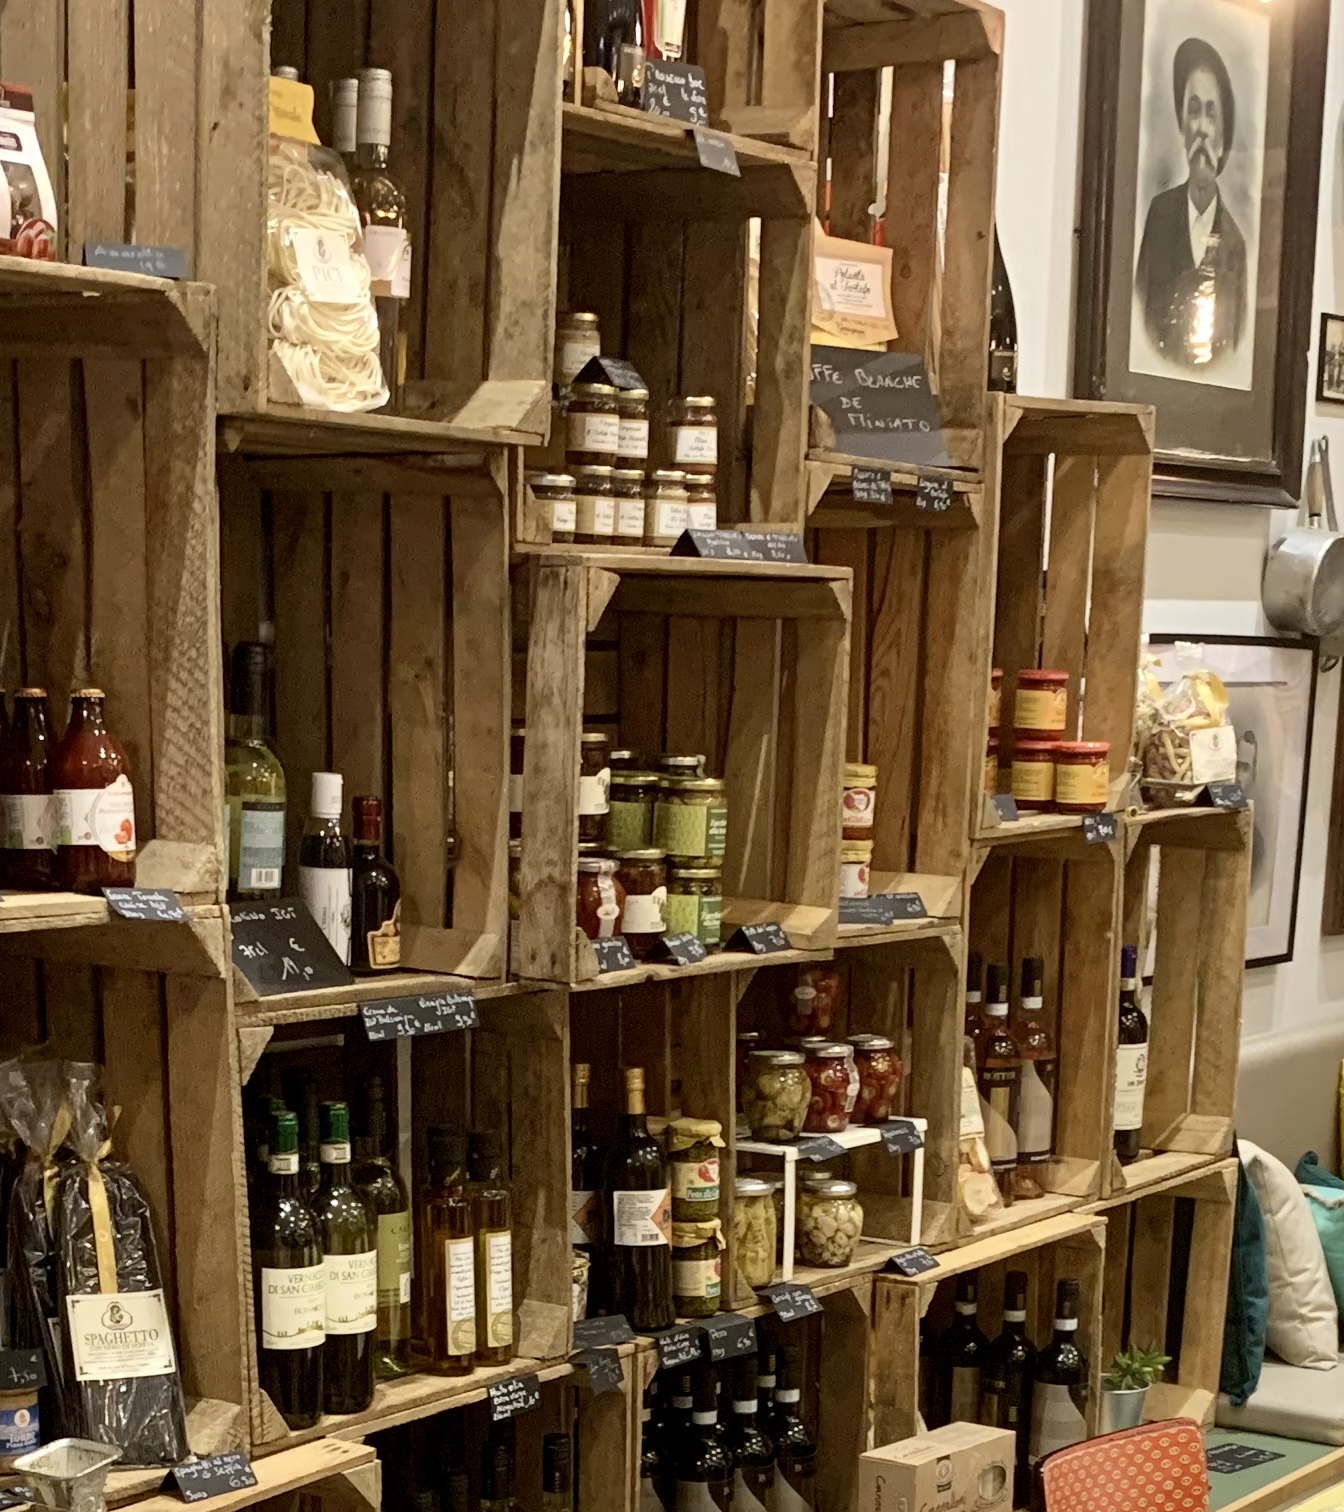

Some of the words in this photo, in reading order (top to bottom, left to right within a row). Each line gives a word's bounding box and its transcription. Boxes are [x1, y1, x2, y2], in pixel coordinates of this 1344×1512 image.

[329, 1271, 340, 1281] DI
[341, 1270, 360, 1281] SAN
[268, 1285, 279, 1295] DI
[280, 1283, 300, 1294] SAN
[83, 1328, 160, 1347] SPAGHETTO
